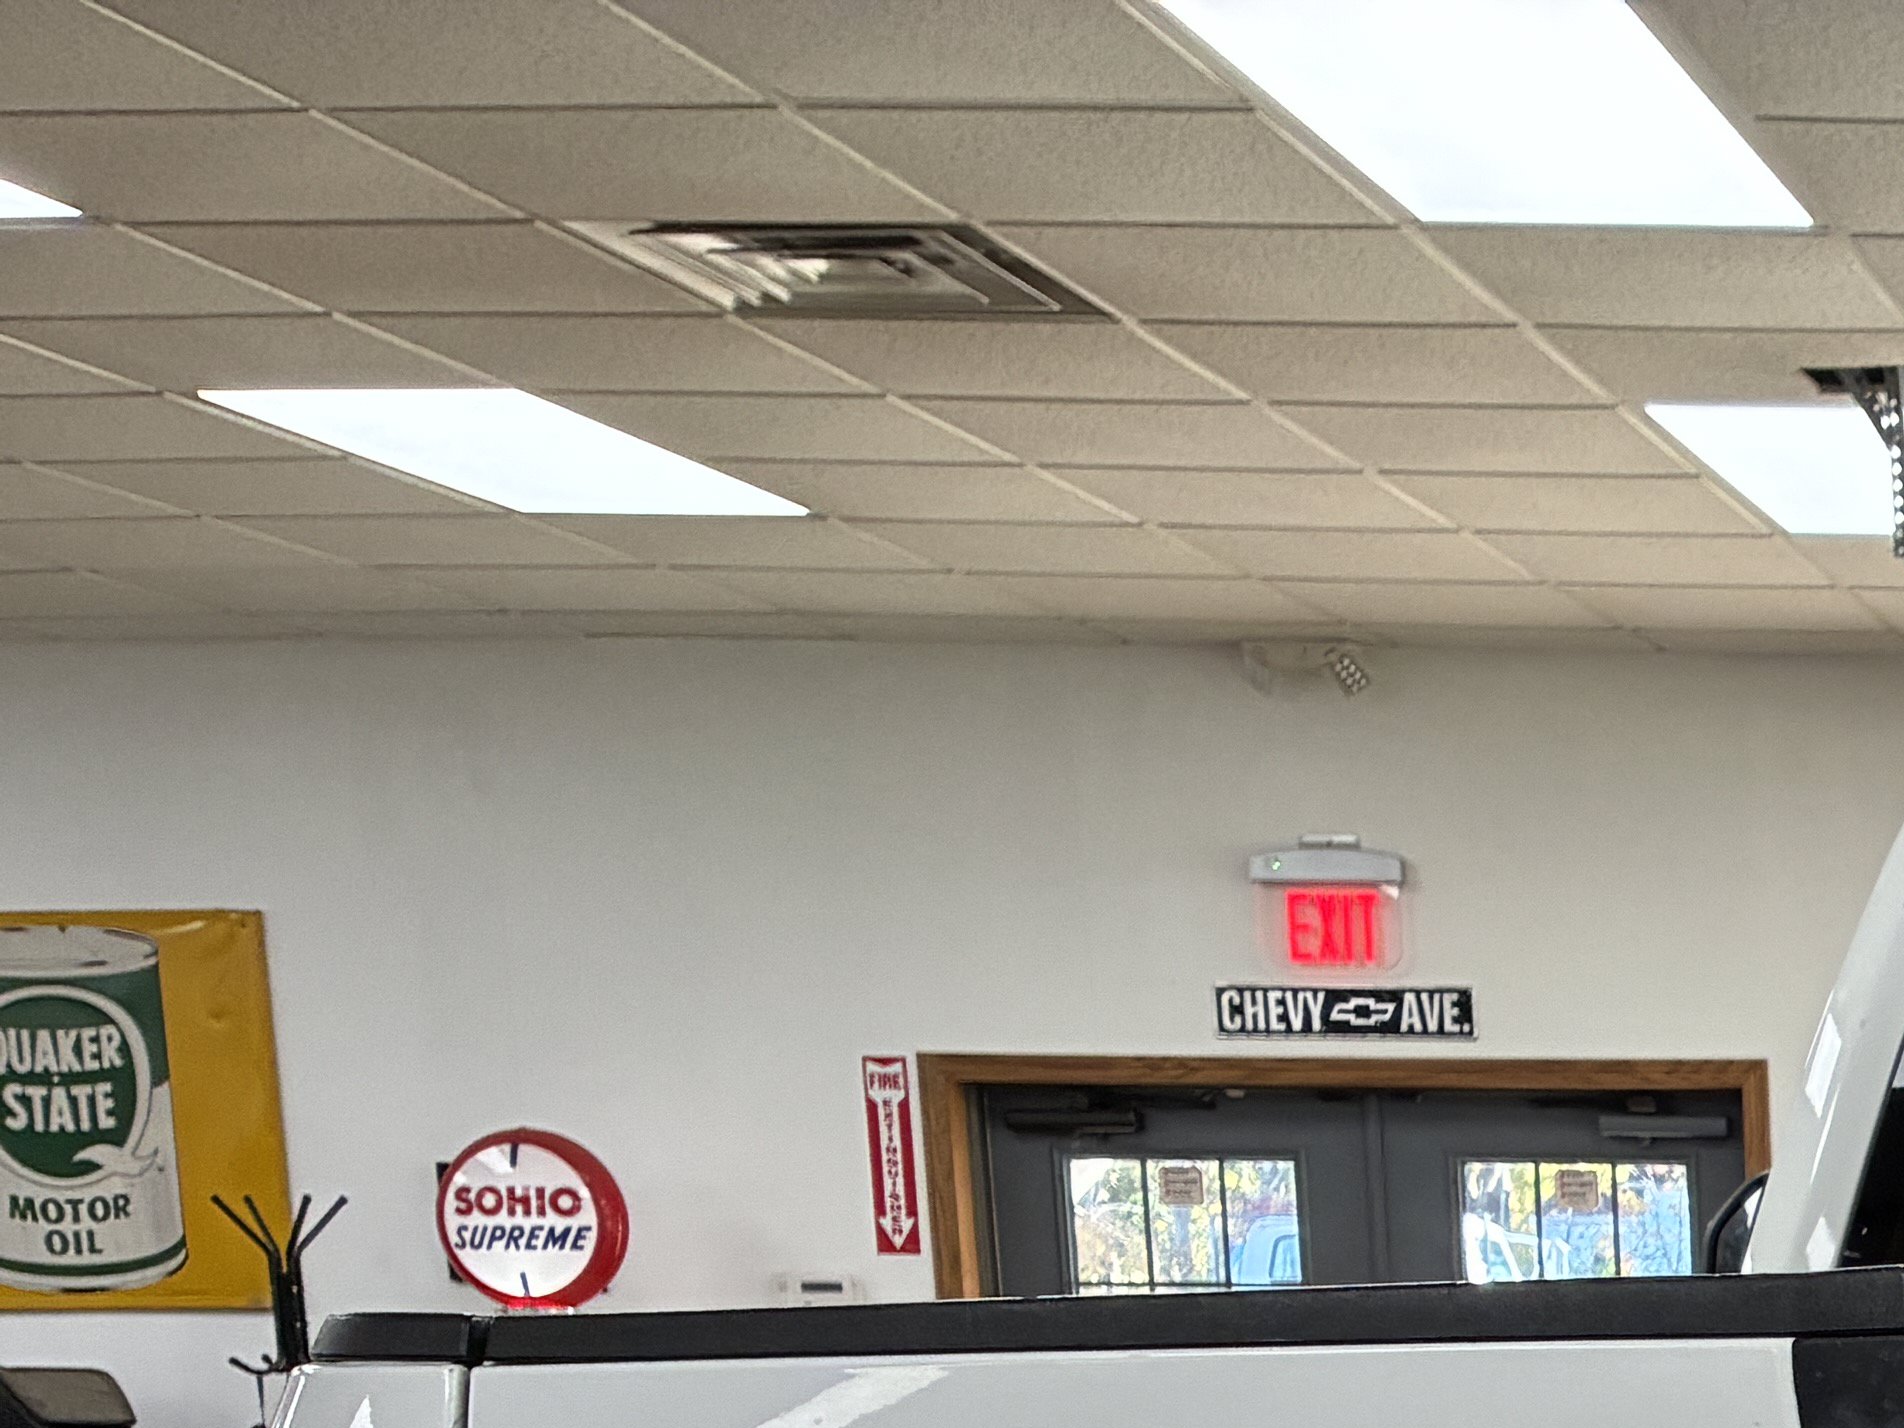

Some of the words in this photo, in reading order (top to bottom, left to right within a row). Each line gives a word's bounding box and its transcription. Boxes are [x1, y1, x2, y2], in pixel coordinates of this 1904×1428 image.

[1284, 888, 1381, 964] EXIT
[1219, 988, 1326, 1033] CHEVY
[1399, 991, 1471, 1034] AVE.
[868, 1071, 903, 1091] FIRE
[3, 1081, 118, 1134] STATE
[9, 1193, 131, 1224] MOTOR
[454, 1184, 583, 1219] SOHIO
[44, 1228, 104, 1256] OIL
[454, 1223, 593, 1252] SUPREME
